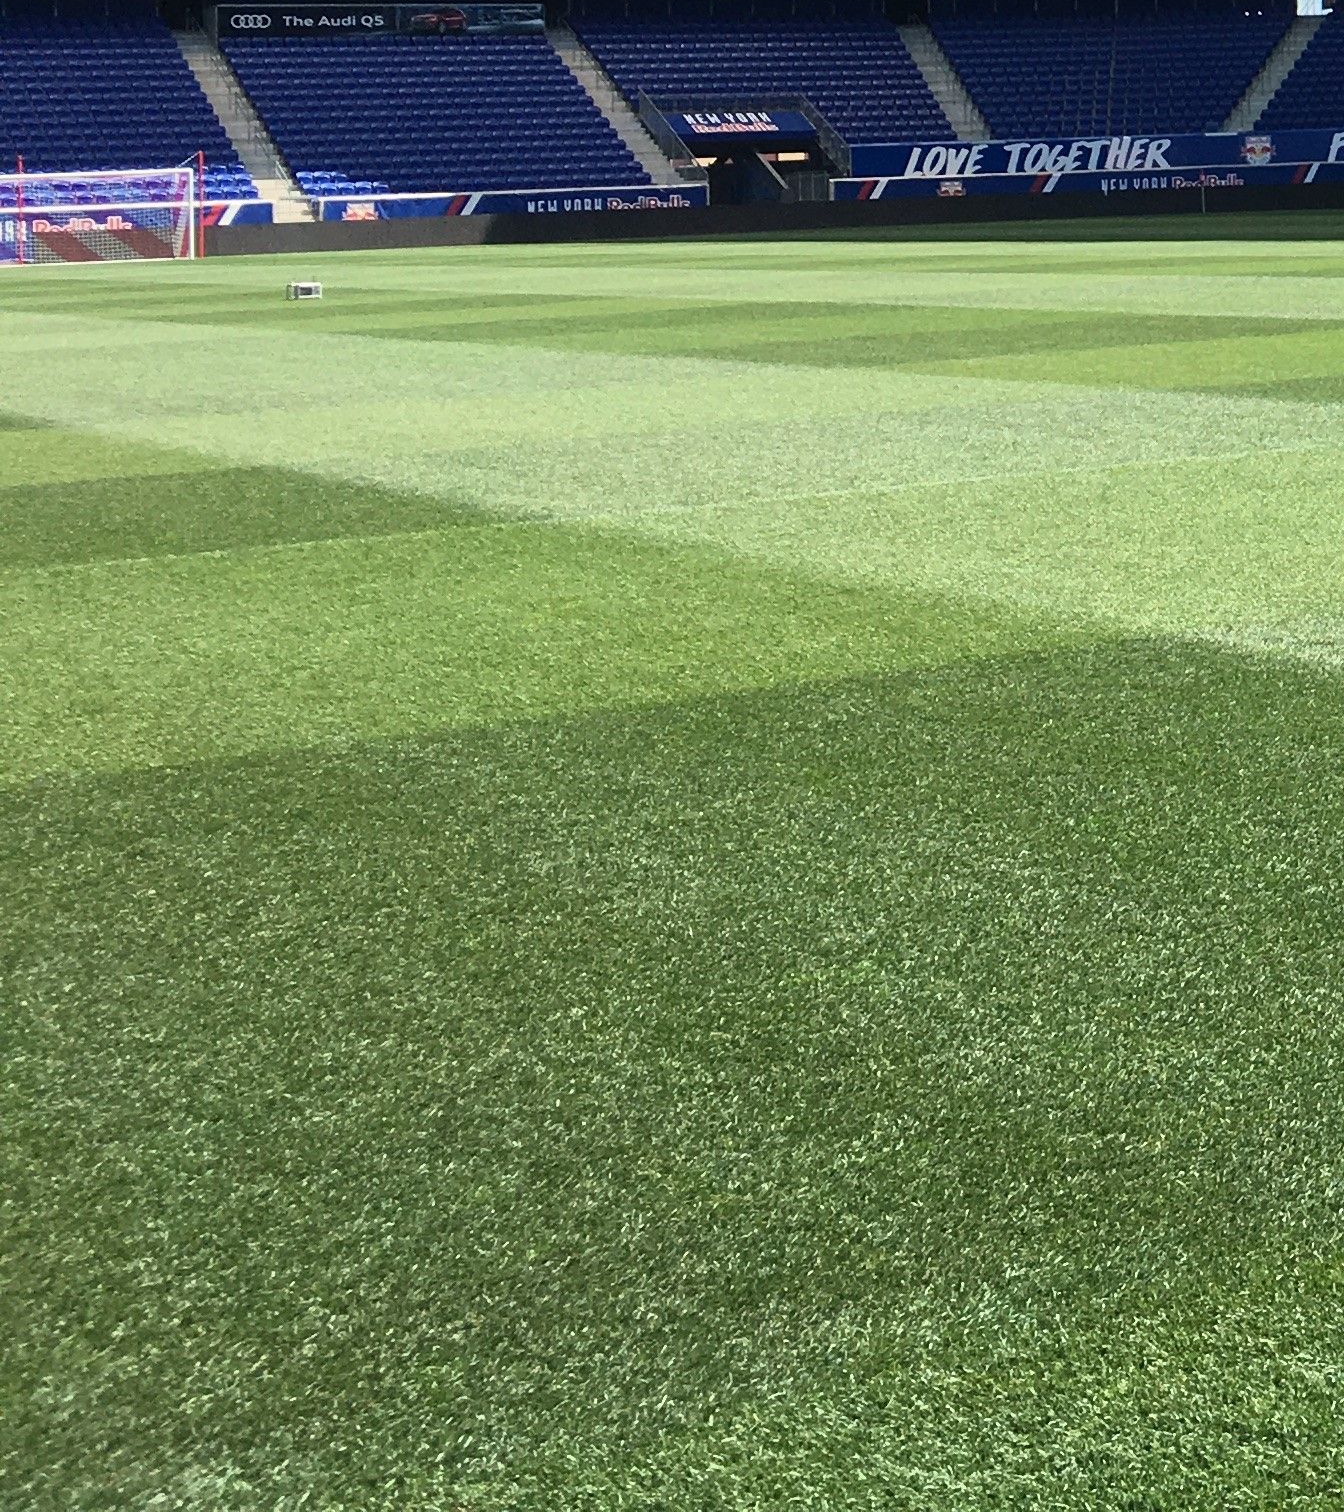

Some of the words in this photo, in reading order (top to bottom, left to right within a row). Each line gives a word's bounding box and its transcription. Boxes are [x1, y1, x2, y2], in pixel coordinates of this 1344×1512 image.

[282, 14, 314, 28] The
[318, 14, 356, 27] Audi
[360, 15, 384, 28] Q5
[683, 113, 721, 125] NEW
[723, 112, 772, 123] YORK
[904, 144, 989, 177] LOVE
[1003, 136, 1172, 174] TOGETHER
